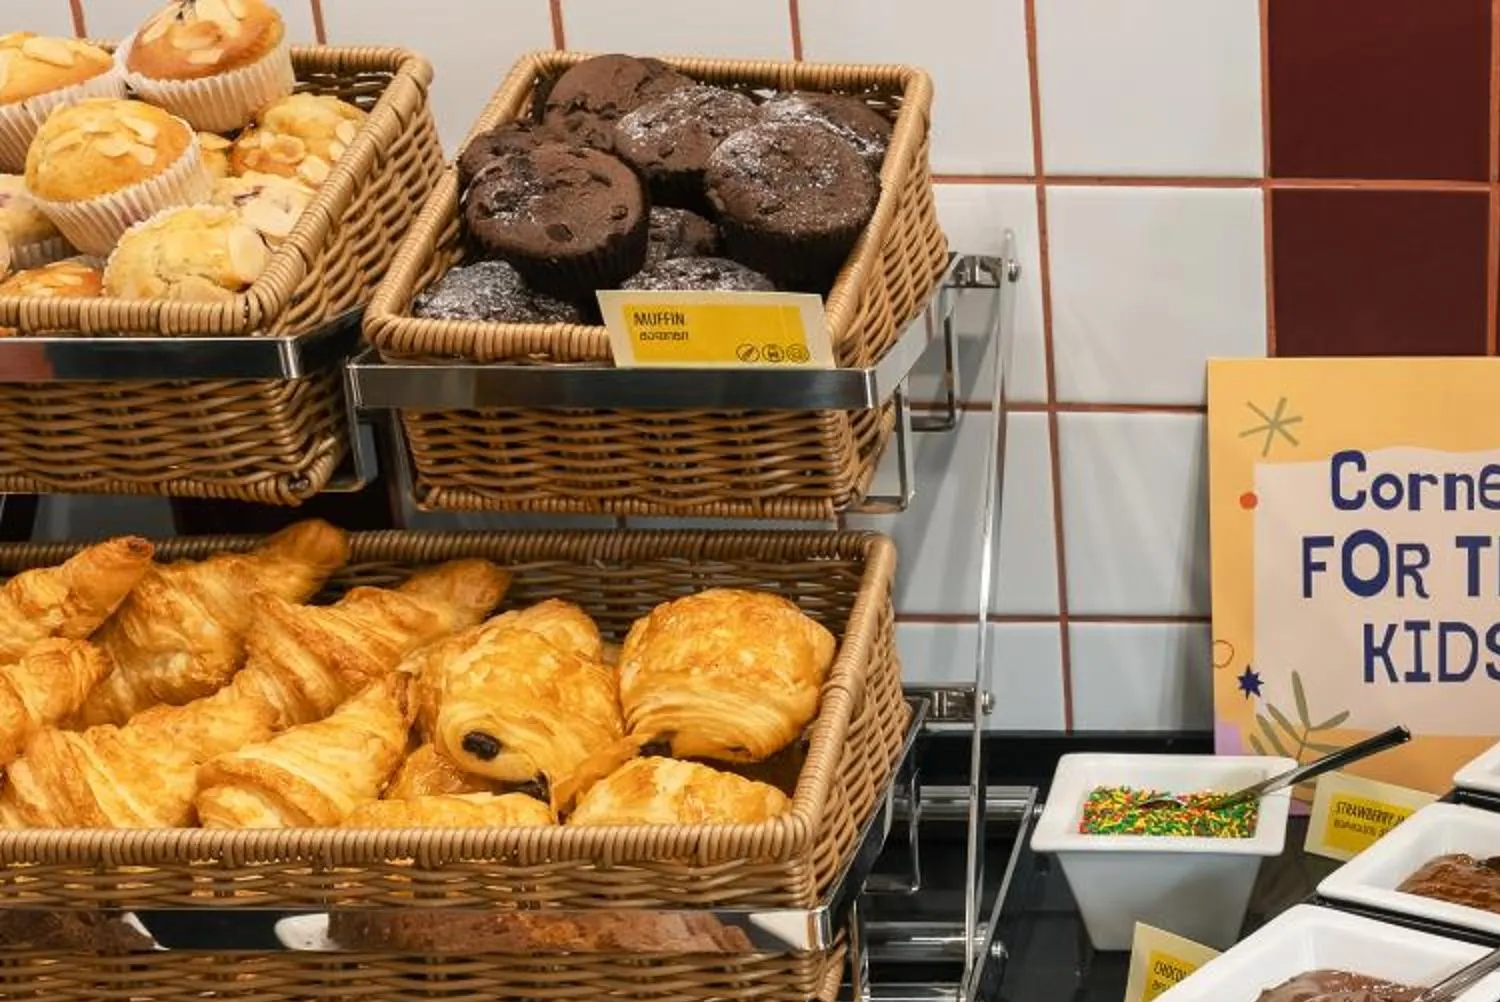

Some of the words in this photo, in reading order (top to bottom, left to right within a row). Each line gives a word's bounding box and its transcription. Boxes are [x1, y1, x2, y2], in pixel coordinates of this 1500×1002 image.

[634, 312, 685, 325] MUFFIN
[1302, 529, 1430, 599] FOR
[1336, 802, 1394, 825] STRAWBERRY
